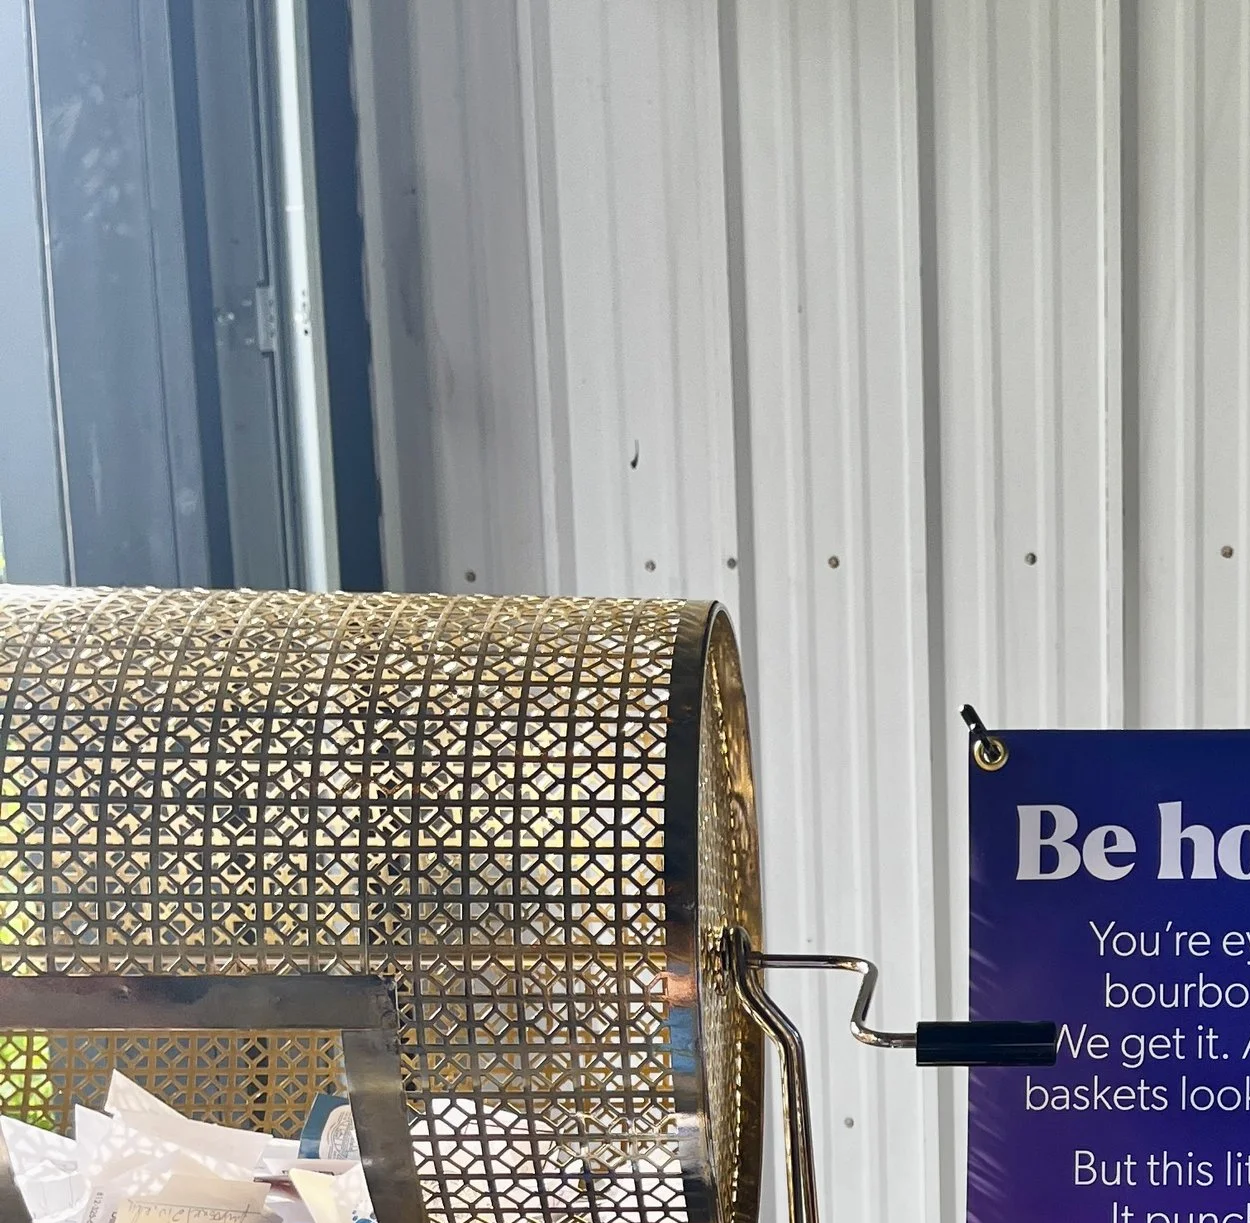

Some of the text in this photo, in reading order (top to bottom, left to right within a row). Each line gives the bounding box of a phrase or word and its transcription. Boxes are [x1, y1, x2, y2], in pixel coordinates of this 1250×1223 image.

[1015, 804, 1137, 881] Be
[1055, 1023, 1109, 1058] We
[1121, 1027, 1186, 1069] get
[1197, 1024, 1229, 1060] it.
[1026, 1075, 1168, 1111] baskets
[1074, 1150, 1137, 1186] But
[1146, 1150, 1214, 1187] this
